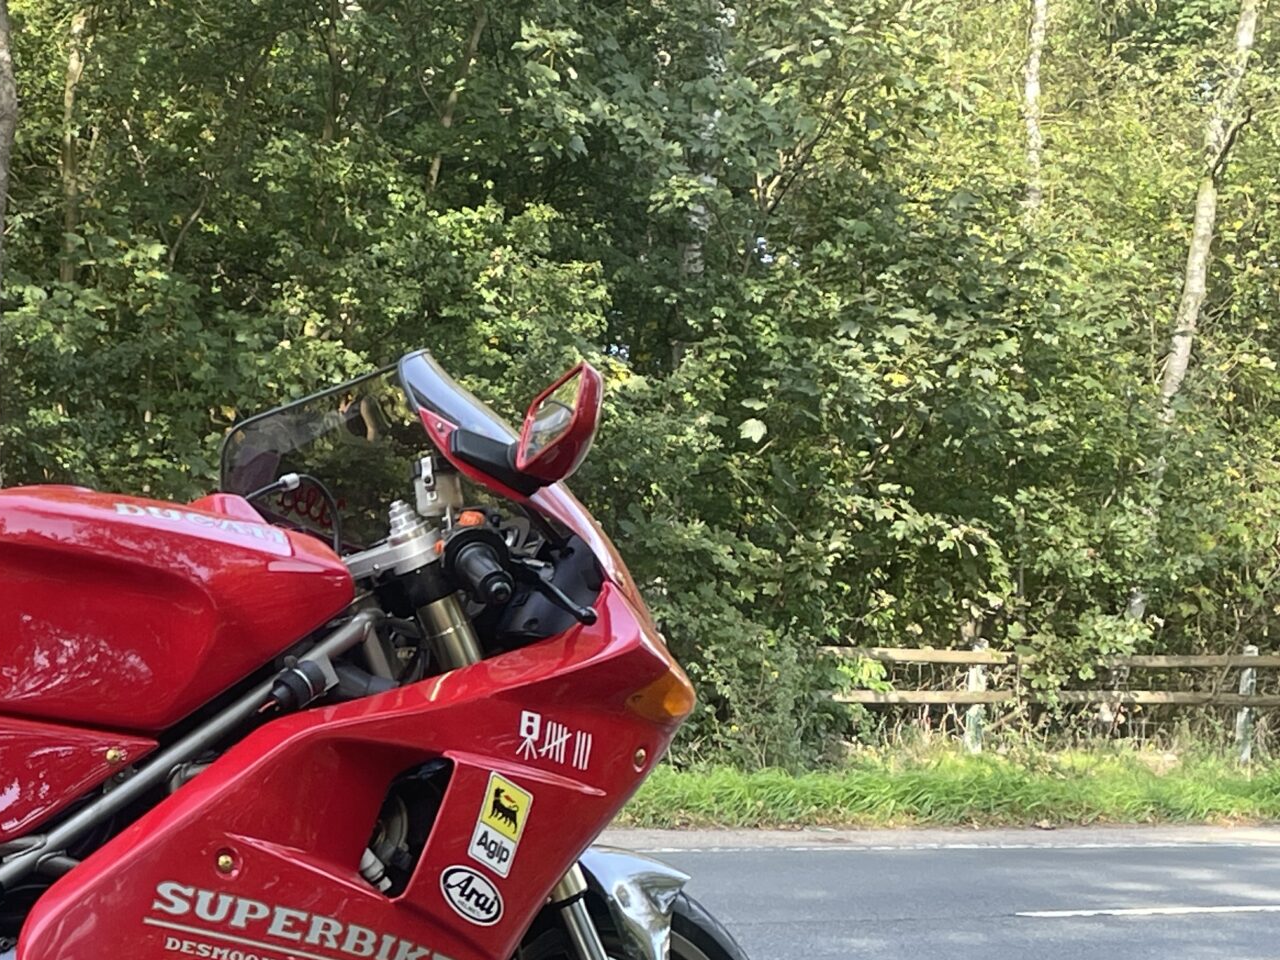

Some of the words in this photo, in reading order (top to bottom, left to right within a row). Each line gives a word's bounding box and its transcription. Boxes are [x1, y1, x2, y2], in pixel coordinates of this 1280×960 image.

[113, 502, 288, 546] DUCATI
[476, 830, 511, 864] Agip
[445, 875, 498, 915] Arai
